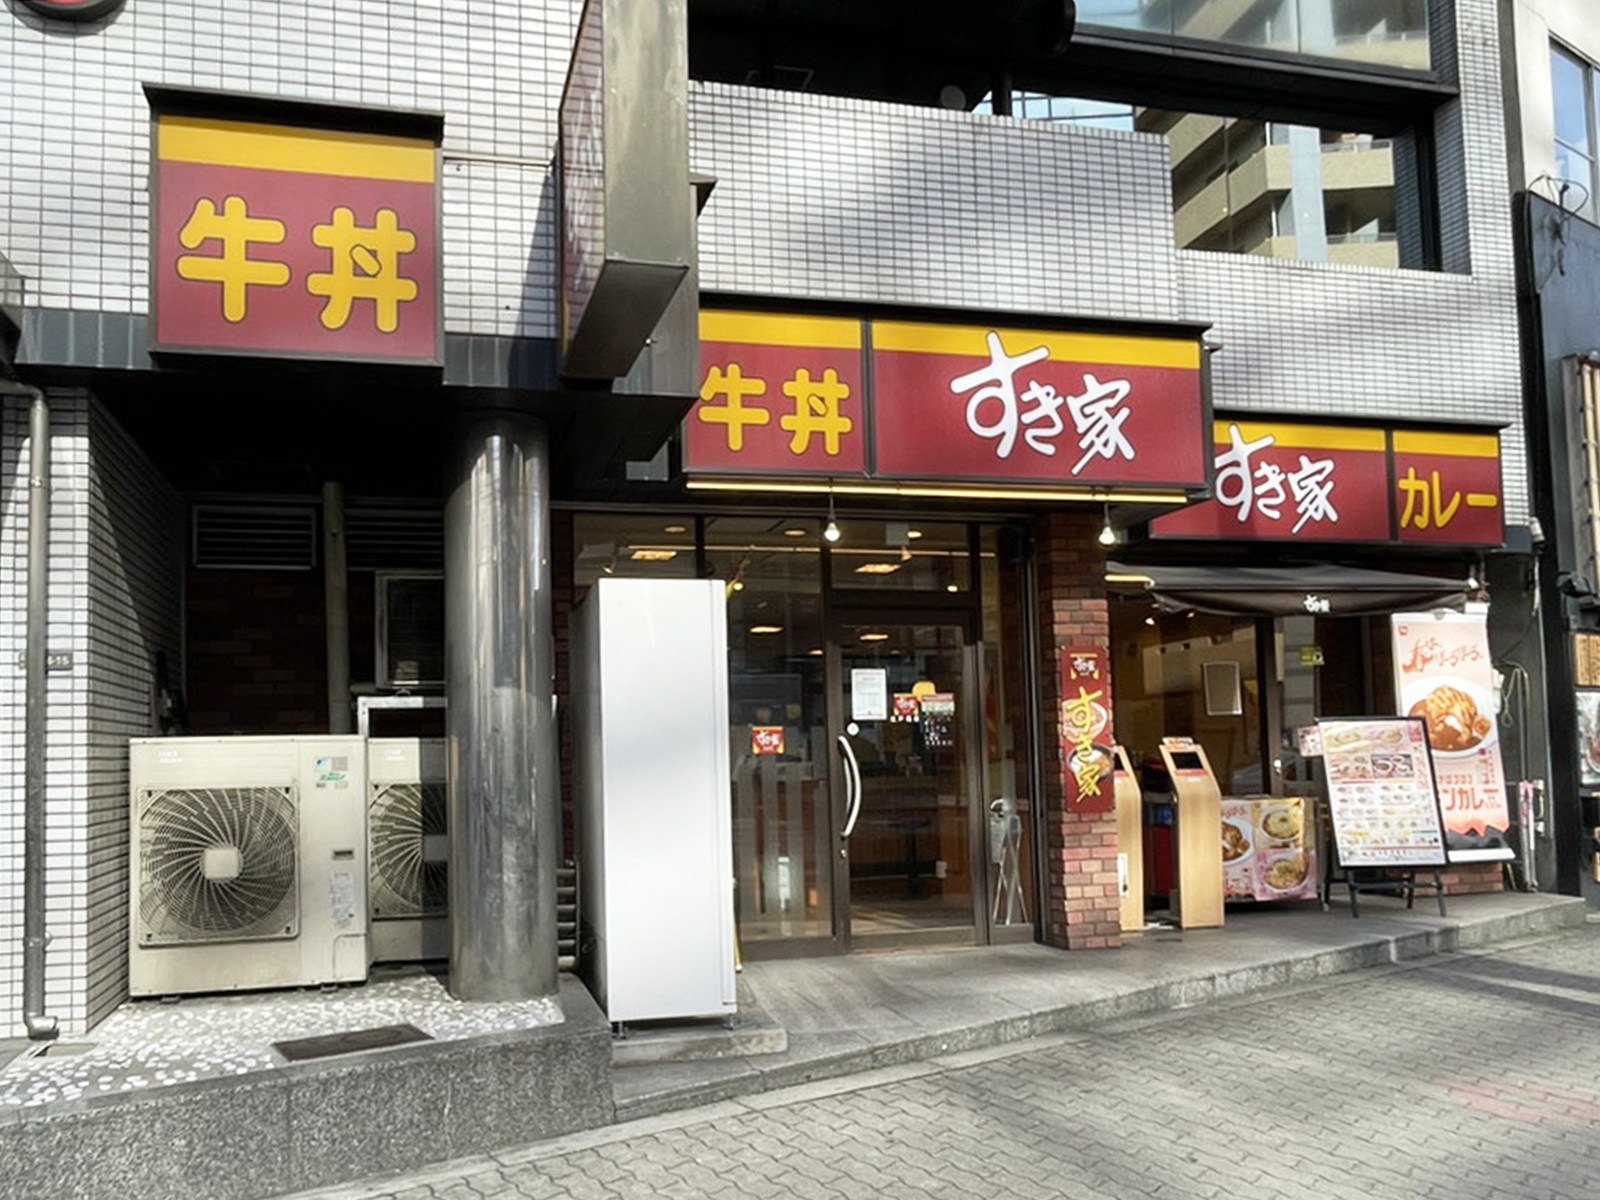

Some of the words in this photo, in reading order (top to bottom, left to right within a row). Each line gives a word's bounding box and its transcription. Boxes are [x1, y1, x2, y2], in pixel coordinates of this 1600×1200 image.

[177, 194, 418, 334] 牛丼
[698, 361, 854, 456] 牛丼
[950, 329, 1137, 476] すき家
[1214, 422, 1339, 534] すき家
[1397, 466, 1499, 530] カレー
[1066, 685, 1104, 803] すき家
[1438, 787, 1499, 811] ンカレー
